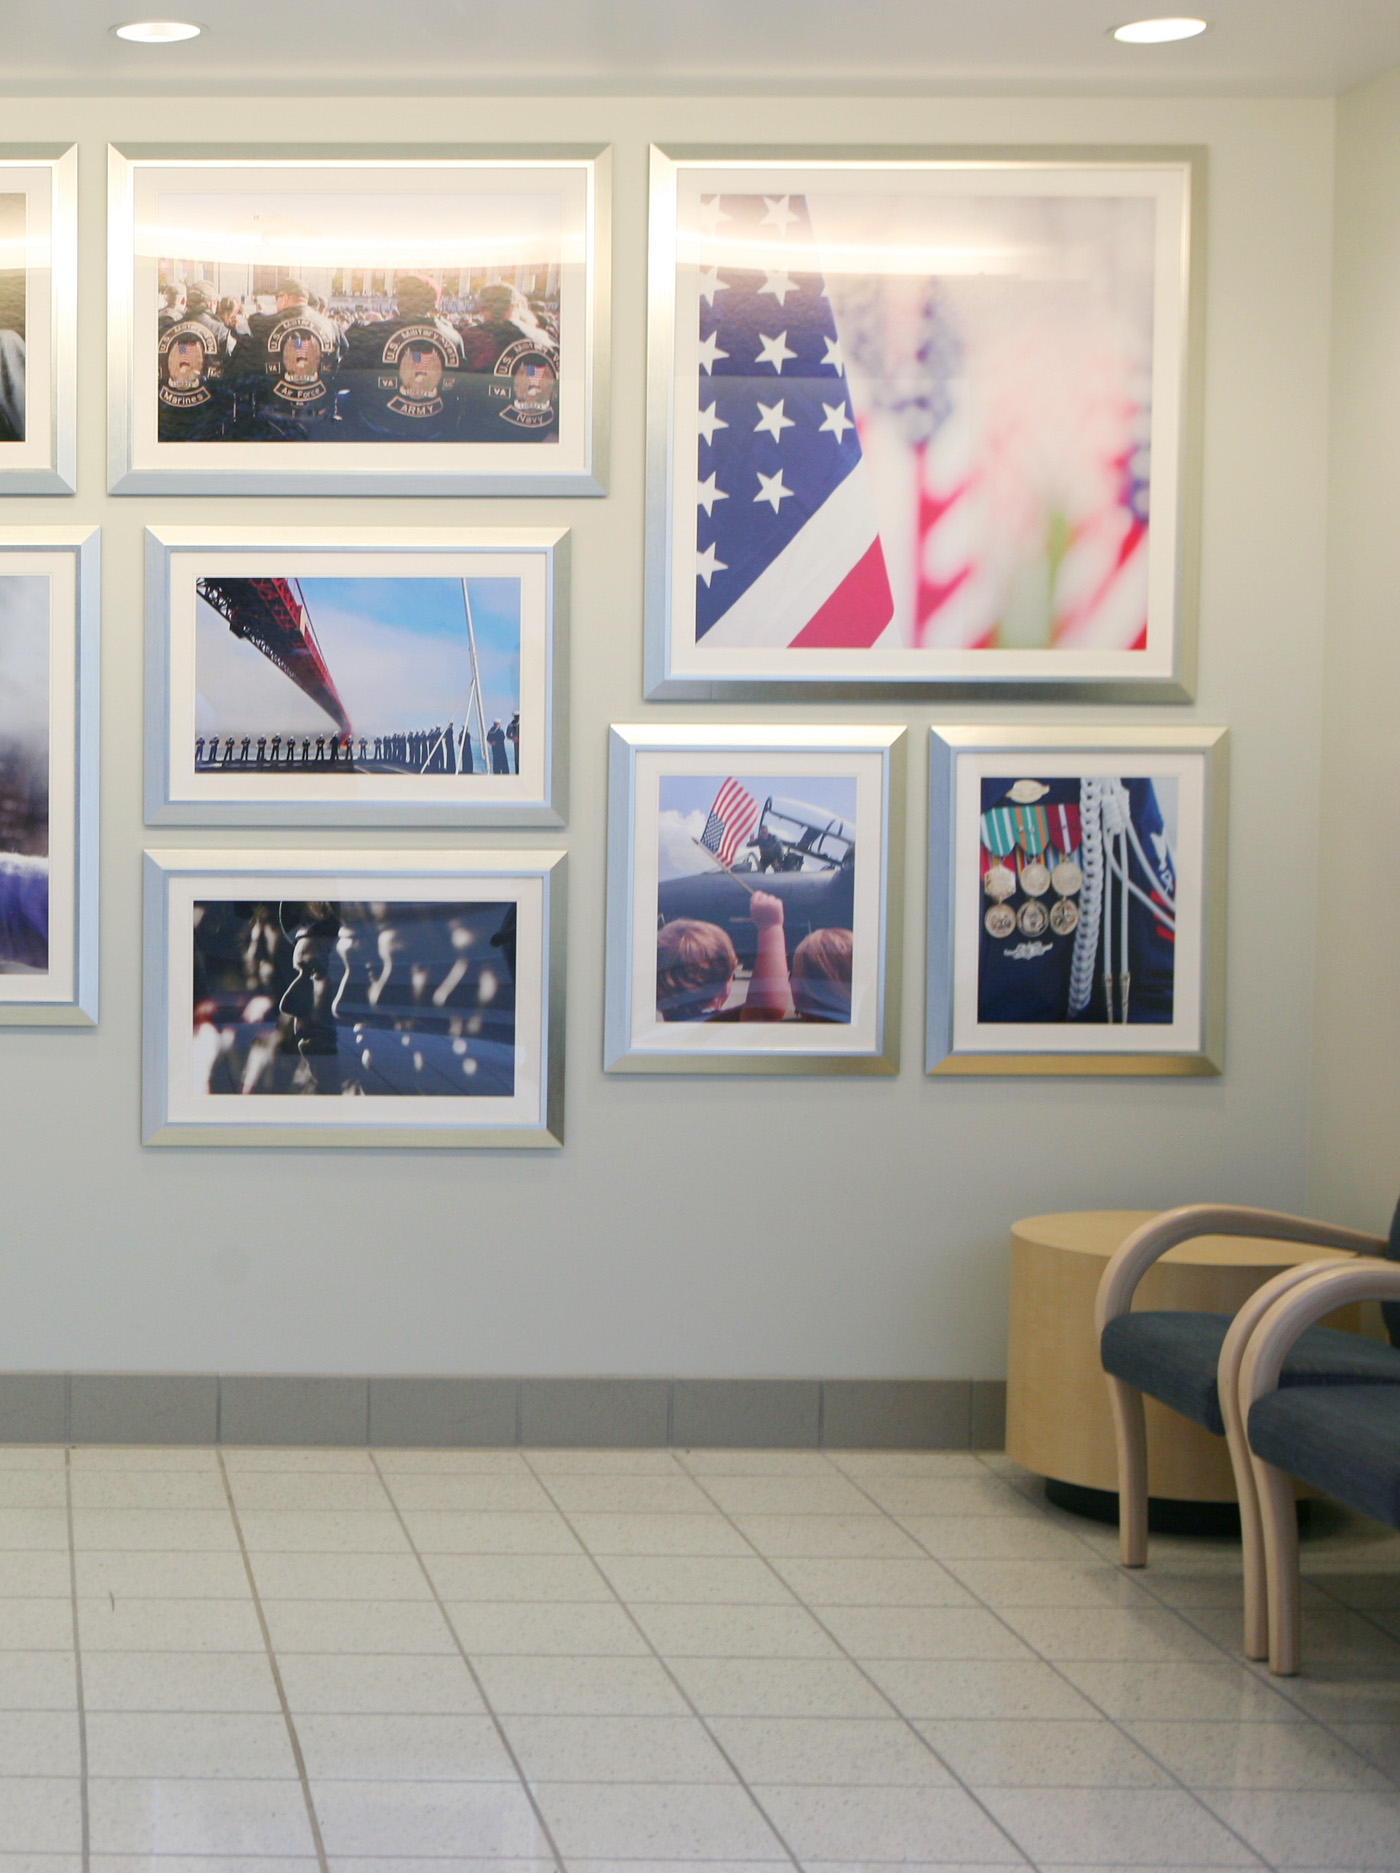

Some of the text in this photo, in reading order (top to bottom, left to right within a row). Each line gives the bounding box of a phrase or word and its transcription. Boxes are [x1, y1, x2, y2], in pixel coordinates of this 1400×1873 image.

[382, 379, 394, 387] VA
[281, 387, 320, 398] Air Force
[493, 387, 506, 396] VA
[163, 391, 204, 405] Marines
[400, 403, 434, 415] ARMY
[517, 412, 543, 424] Navy
